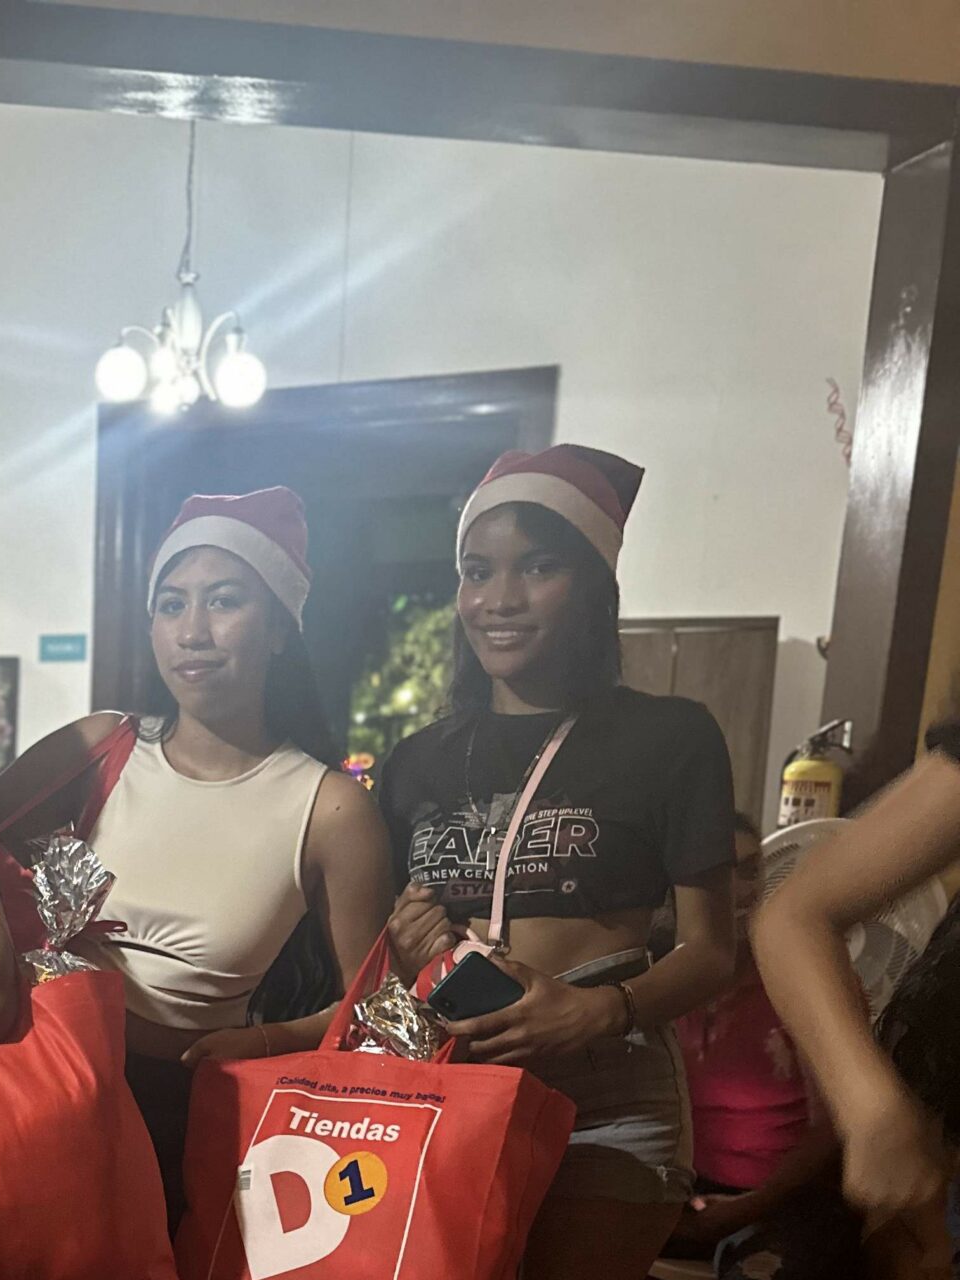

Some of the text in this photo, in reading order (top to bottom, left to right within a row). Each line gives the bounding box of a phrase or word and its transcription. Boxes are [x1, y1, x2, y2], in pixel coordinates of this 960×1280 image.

[538, 809, 557, 818] STEP
[432, 868, 460, 879] NEW
[464, 862, 549, 880] GENATION
[451, 882, 496, 897] STYL
[349, 1086, 387, 1097] precios
[390, 1091, 413, 1101] muy
[289, 1105, 401, 1143] Tiendas
